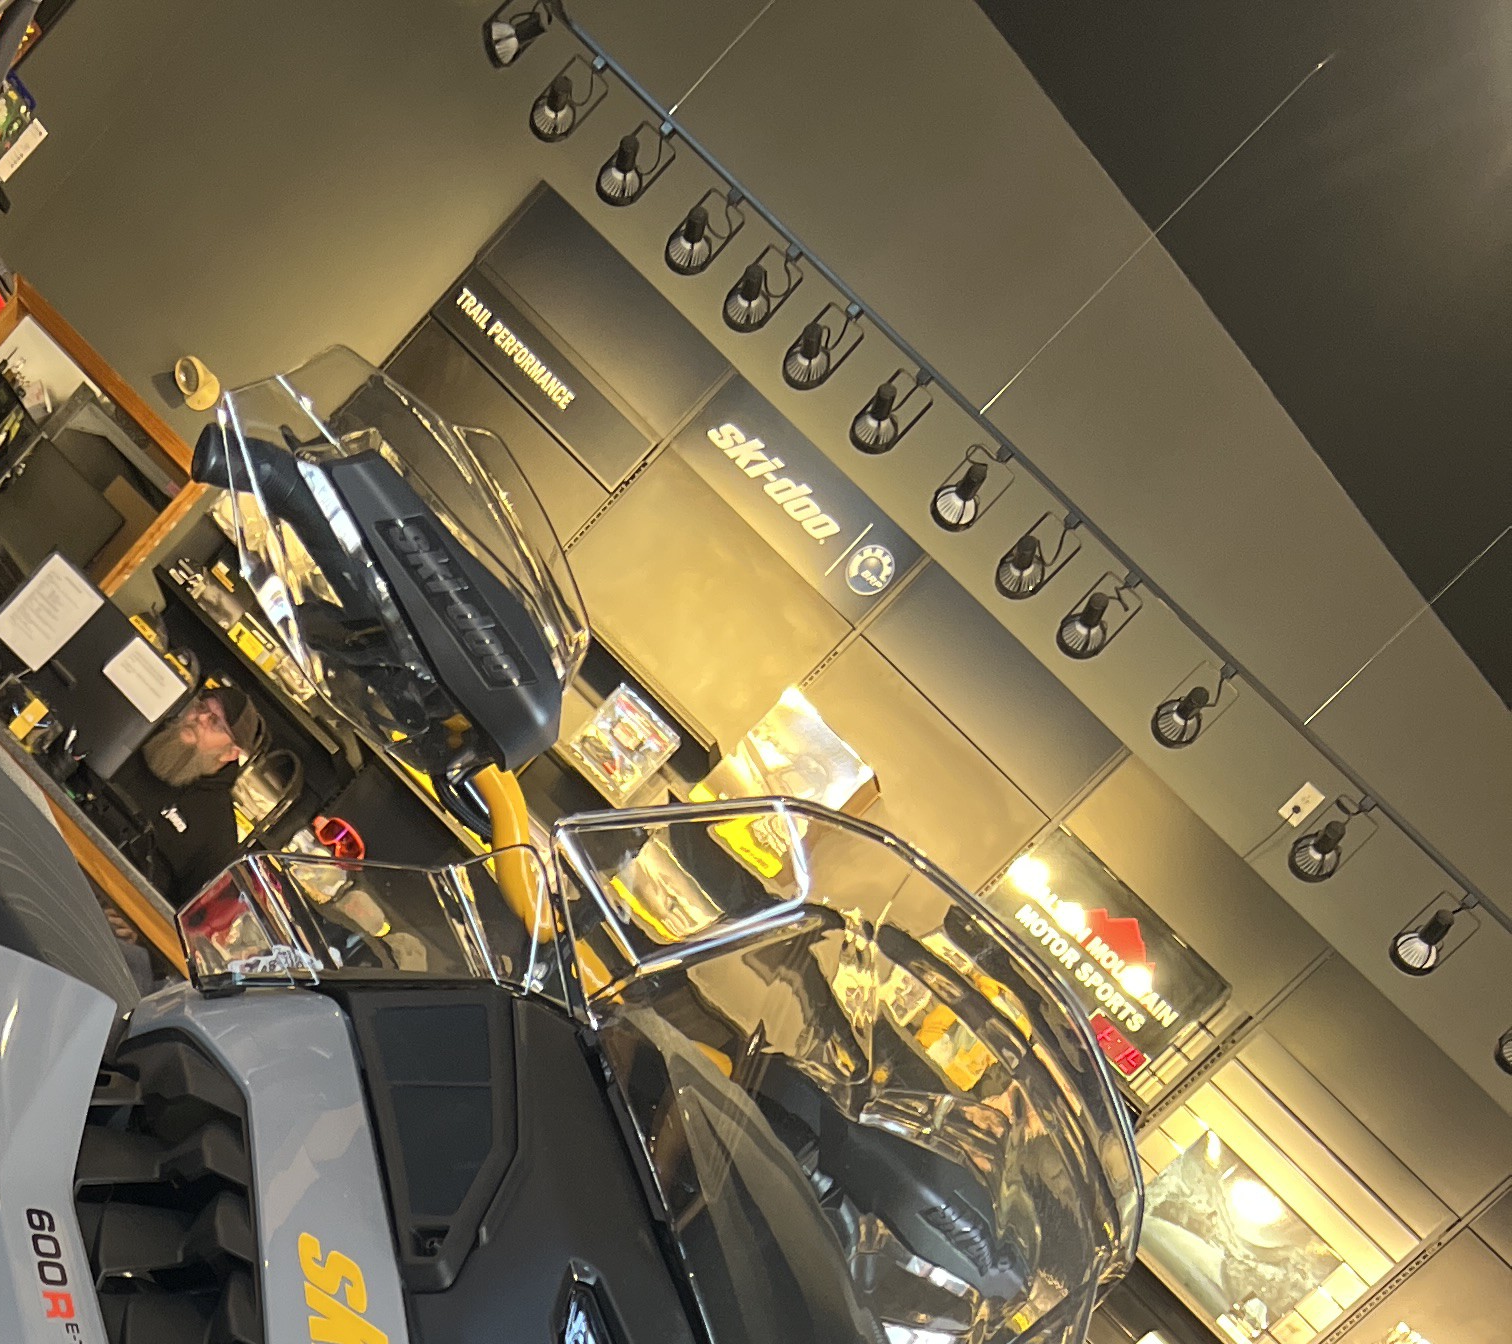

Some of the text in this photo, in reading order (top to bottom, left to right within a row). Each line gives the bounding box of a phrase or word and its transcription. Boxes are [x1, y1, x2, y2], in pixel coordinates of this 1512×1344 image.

[457, 287, 575, 411] TRAIL PERFORMANCE
[861, 569, 884, 590] BRP
[1013, 902, 1148, 1034] MOTOR SPORTS
